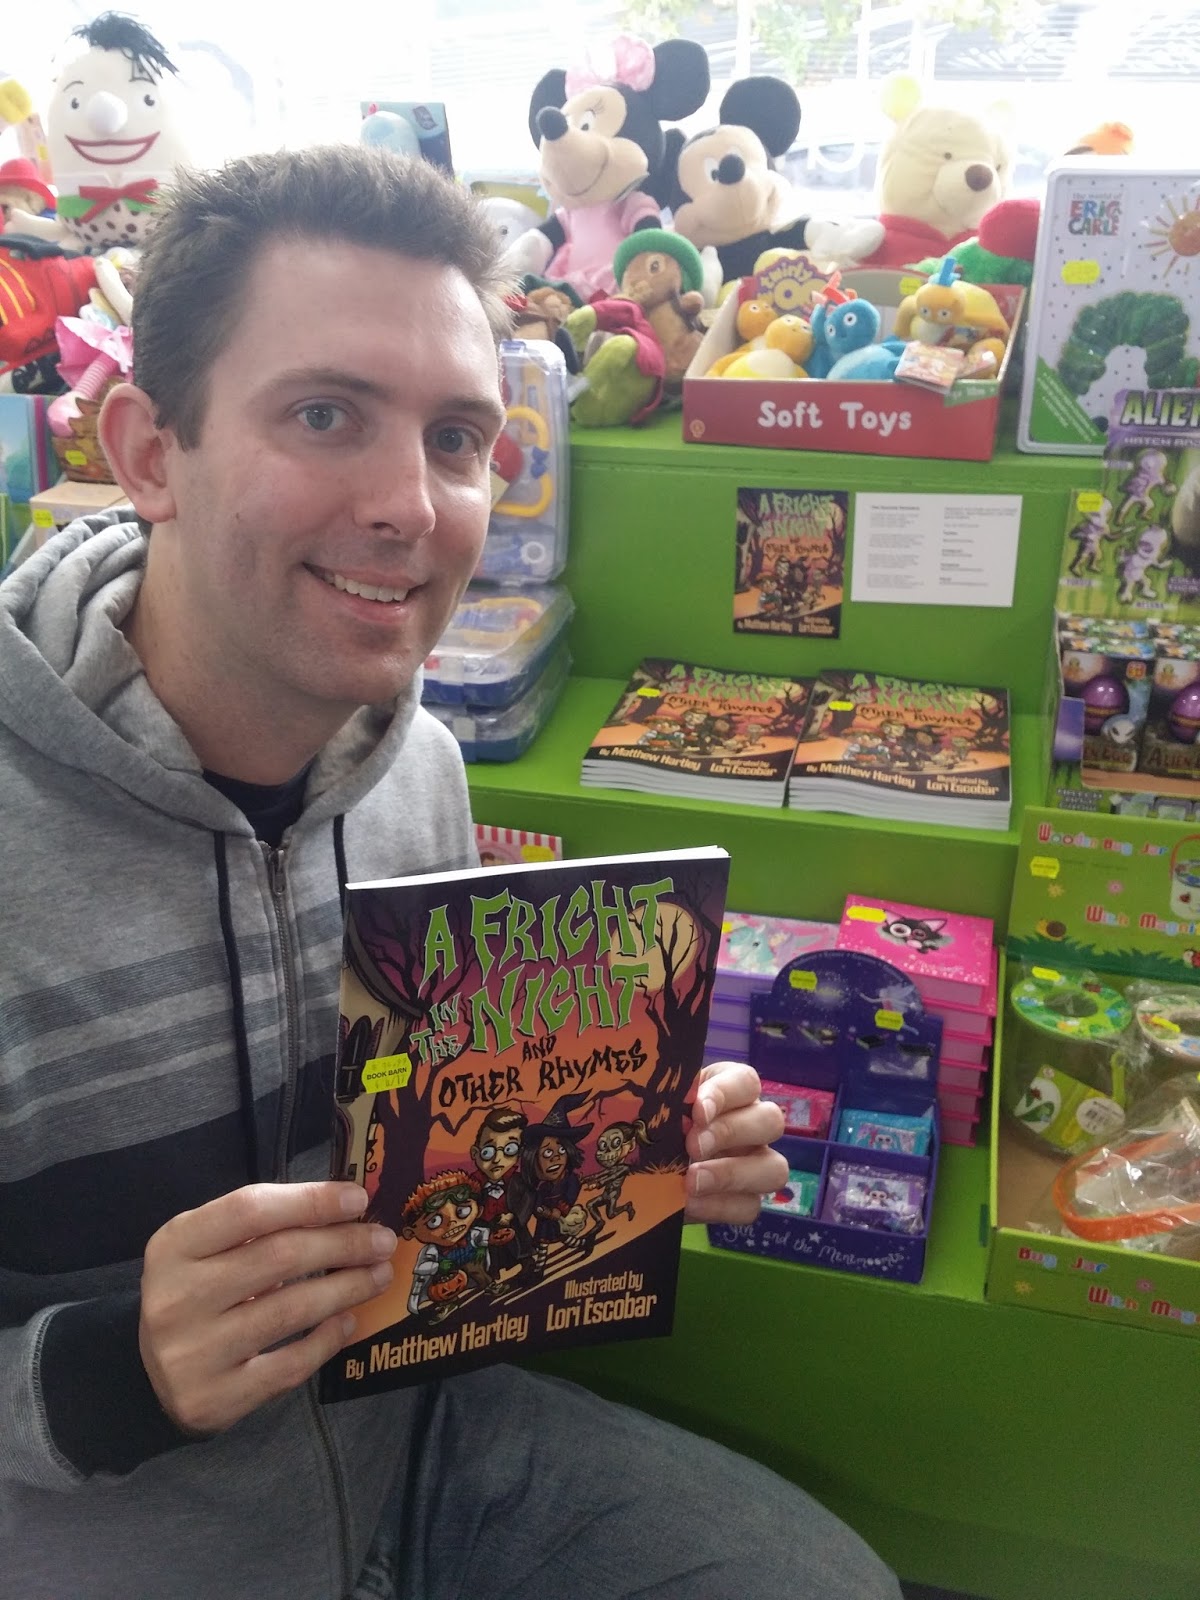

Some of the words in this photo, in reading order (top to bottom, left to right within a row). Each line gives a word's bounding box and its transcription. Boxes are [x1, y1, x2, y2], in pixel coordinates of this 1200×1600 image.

[1070, 199, 1121, 218] ERIC
[1068, 217, 1119, 236] CARLE
[757, 400, 824, 429] Soft
[839, 401, 913, 437] Toys
[666, 663, 686, 680] A
[692, 665, 791, 689] FRIGHT
[850, 673, 869, 690] A
[875, 674, 980, 698] FRIGHT
[611, 746, 661, 763] Matthew
[660, 754, 702, 772] Hartley
[709, 762, 732, 775] Lori
[731, 763, 778, 777] Escobar
[819, 762, 872, 780] Matthew
[871, 769, 917, 789] Hartley
[926, 778, 949, 792] Lori
[949, 780, 1000, 796] Escobar
[1139, 842, 1169, 856] Jar
[418, 903, 457, 998] A
[469, 876, 675, 989] FRIGHT
[428, 991, 461, 1032] IN
[468, 961, 650, 1056] NIGHT
[408, 1027, 463, 1067] THE
[521, 1035, 558, 1064] AND
[366, 1071, 388, 1081] BOOK
[388, 1066, 408, 1077] BARN
[438, 1065, 523, 1108] OTHER
[538, 1037, 649, 1094] RHYMES
[762, 1230, 792, 1246] and
[793, 1237, 813, 1254] the
[1018, 1246, 1058, 1270] Bug
[1071, 1256, 1110, 1274] Jar
[564, 1272, 627, 1301] Illustrated
[627, 1270, 645, 1293] by
[545, 1299, 582, 1333] Lori
[582, 1291, 658, 1326] Escobar
[345, 1358, 365, 1381] By
[368, 1331, 458, 1375] Matthew
[460, 1313, 530, 1354] Hartley
